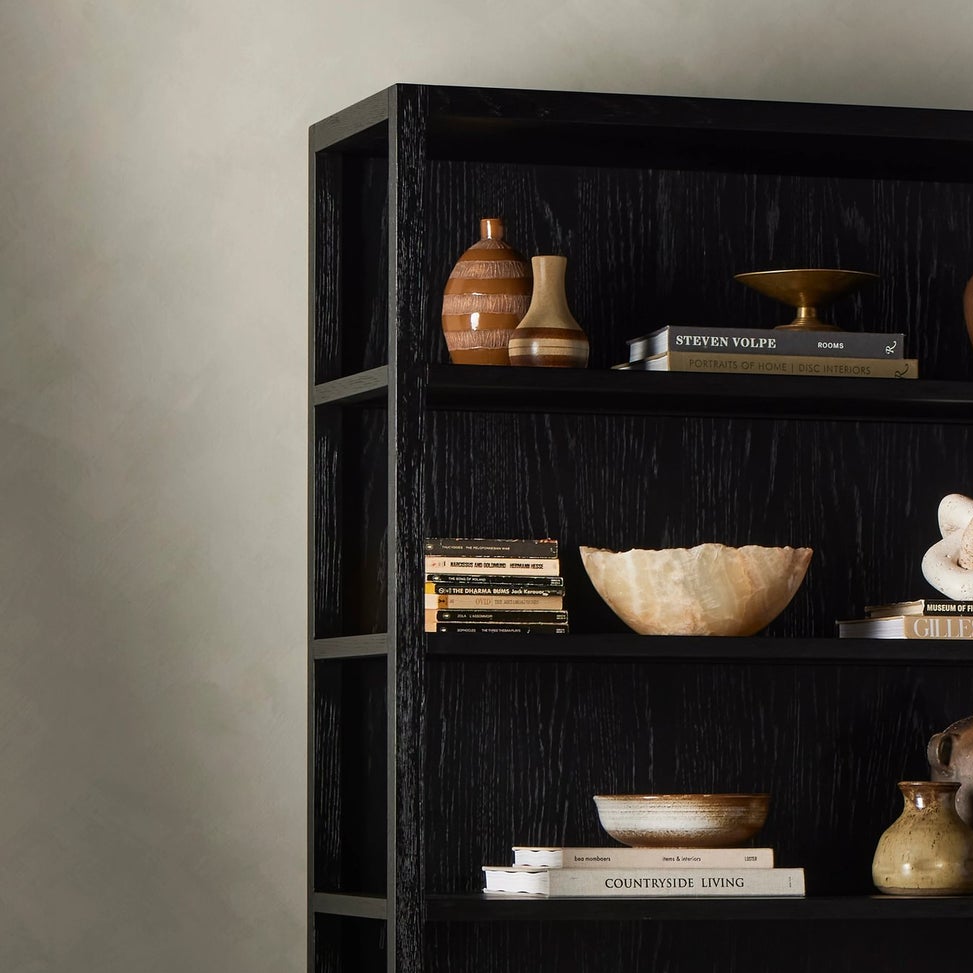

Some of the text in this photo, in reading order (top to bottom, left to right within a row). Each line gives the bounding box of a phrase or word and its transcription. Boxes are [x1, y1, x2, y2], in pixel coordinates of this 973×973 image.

[676, 335, 844, 349] STEVEN VOLPE ROOMS
[689, 359, 737, 369] PORTRAITS
[741, 361, 755, 370] OF
[758, 361, 787, 372] HOME
[799, 363, 820, 373] DISC
[823, 364, 871, 376] INTERIORS
[927, 604, 956, 612] MUSEUM
[957, 604, 966, 613] OF
[605, 878, 744, 889] COUNTRYSIDE LIVING
